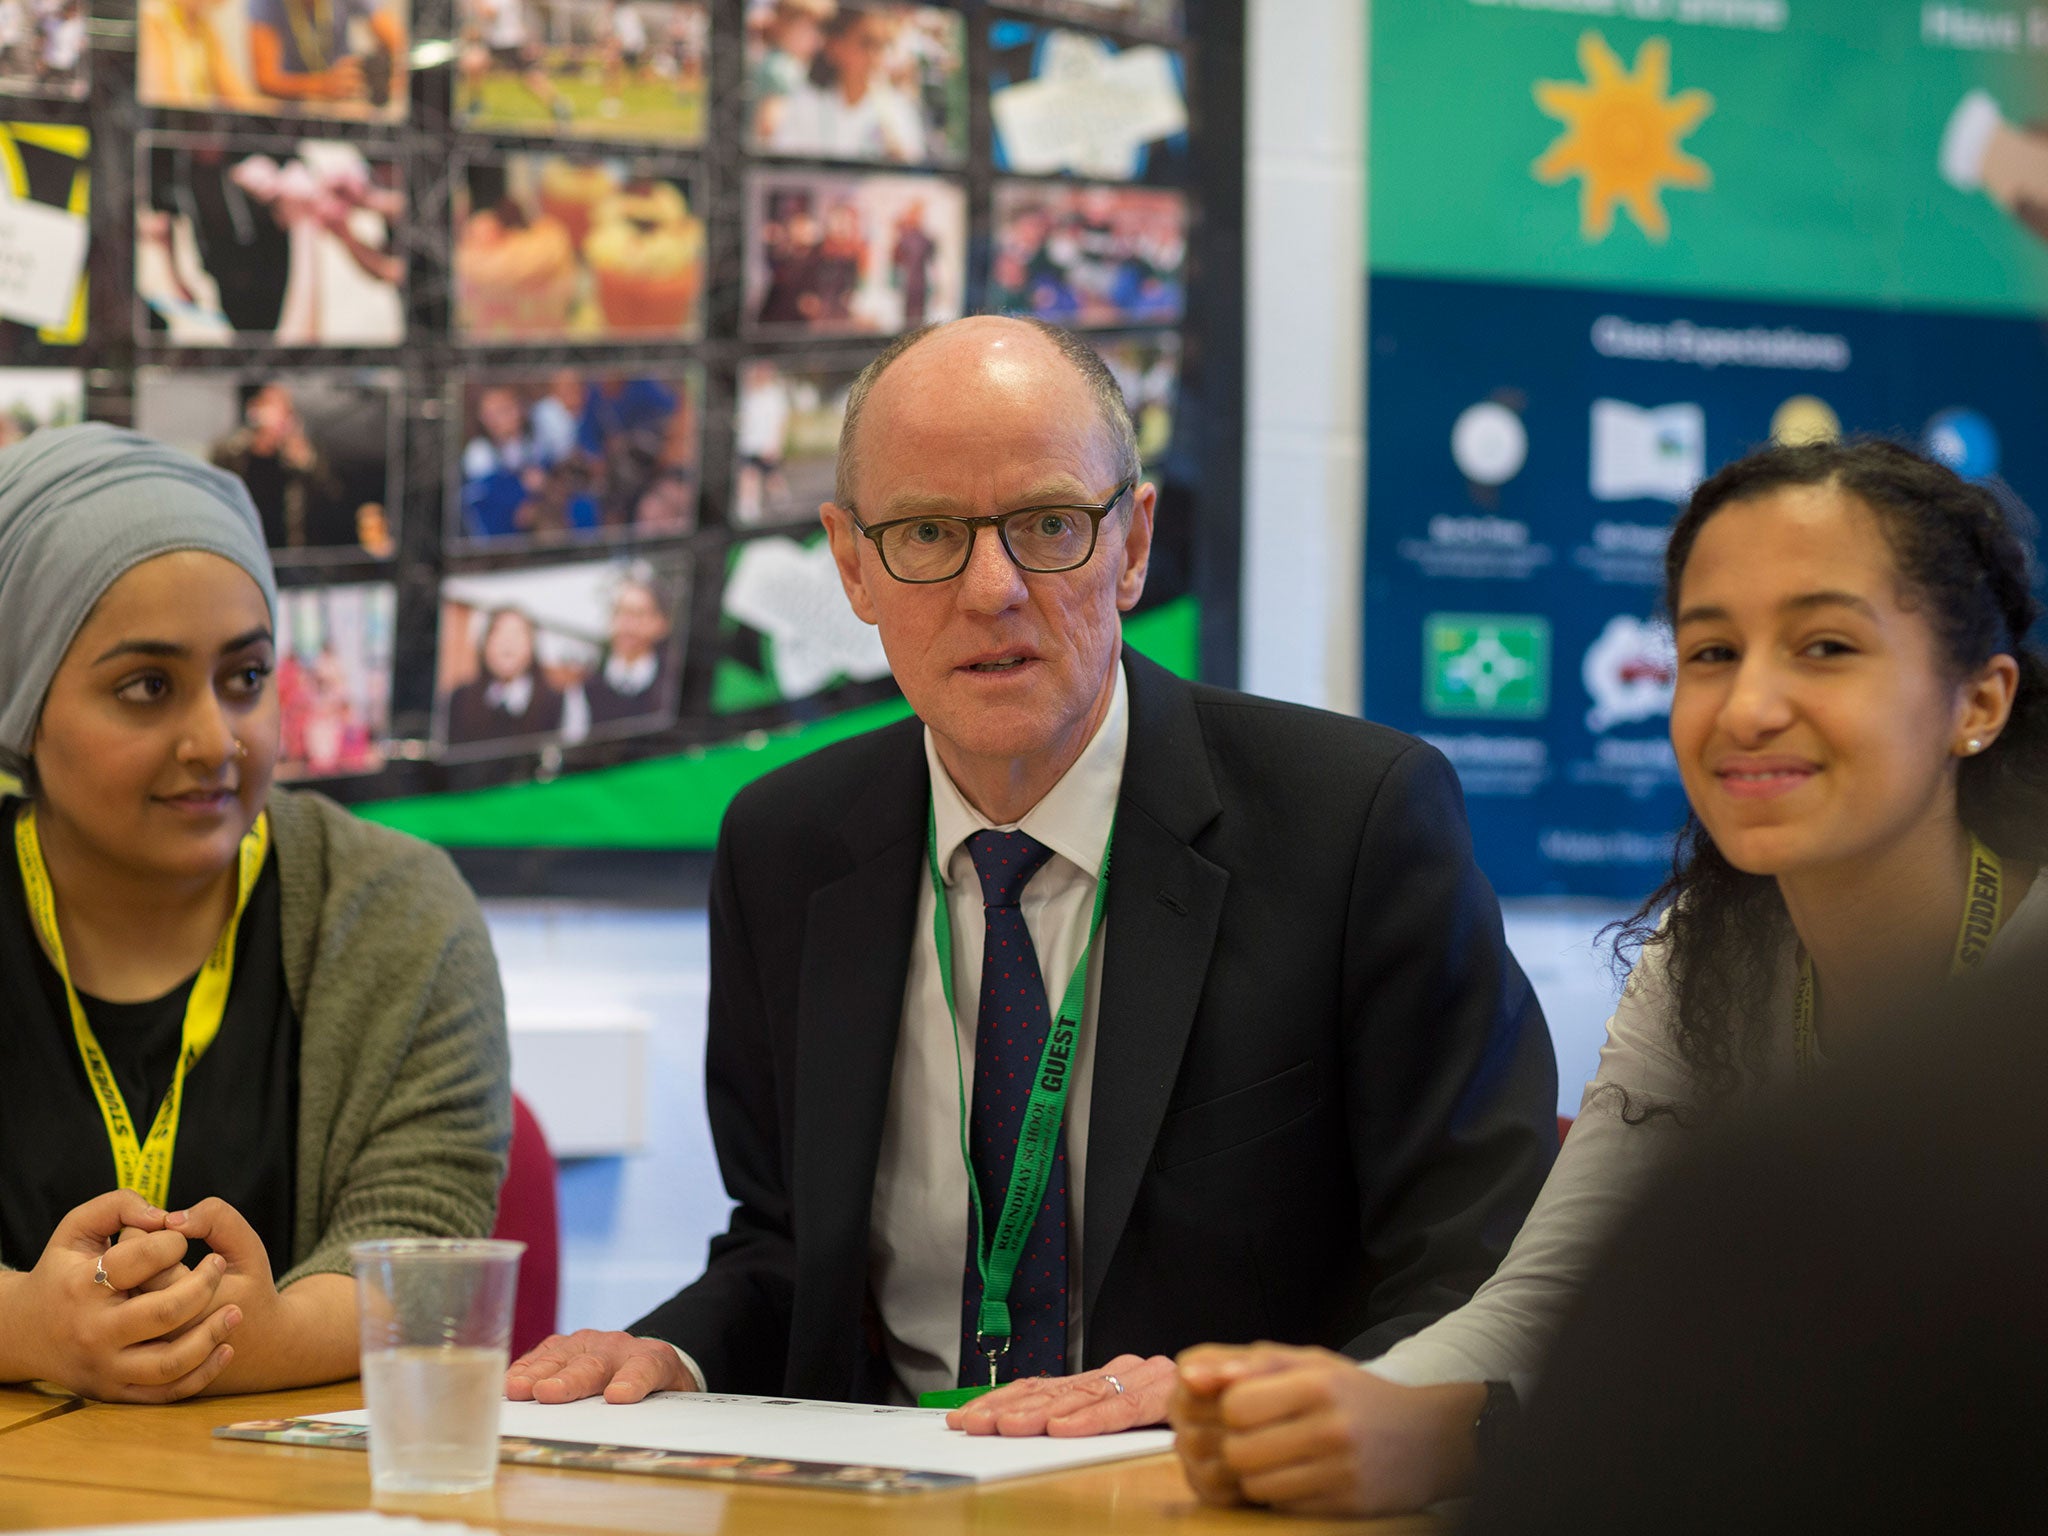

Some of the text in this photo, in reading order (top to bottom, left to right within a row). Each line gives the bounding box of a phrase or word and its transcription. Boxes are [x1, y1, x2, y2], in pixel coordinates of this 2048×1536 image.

[1961, 856, 1999, 966] STUDENT
[86, 1046, 129, 1137] STUDENT
[1041, 1014, 1076, 1092] GUEST
[998, 1100, 1046, 1250] ROUNDHAY SCHOOL
